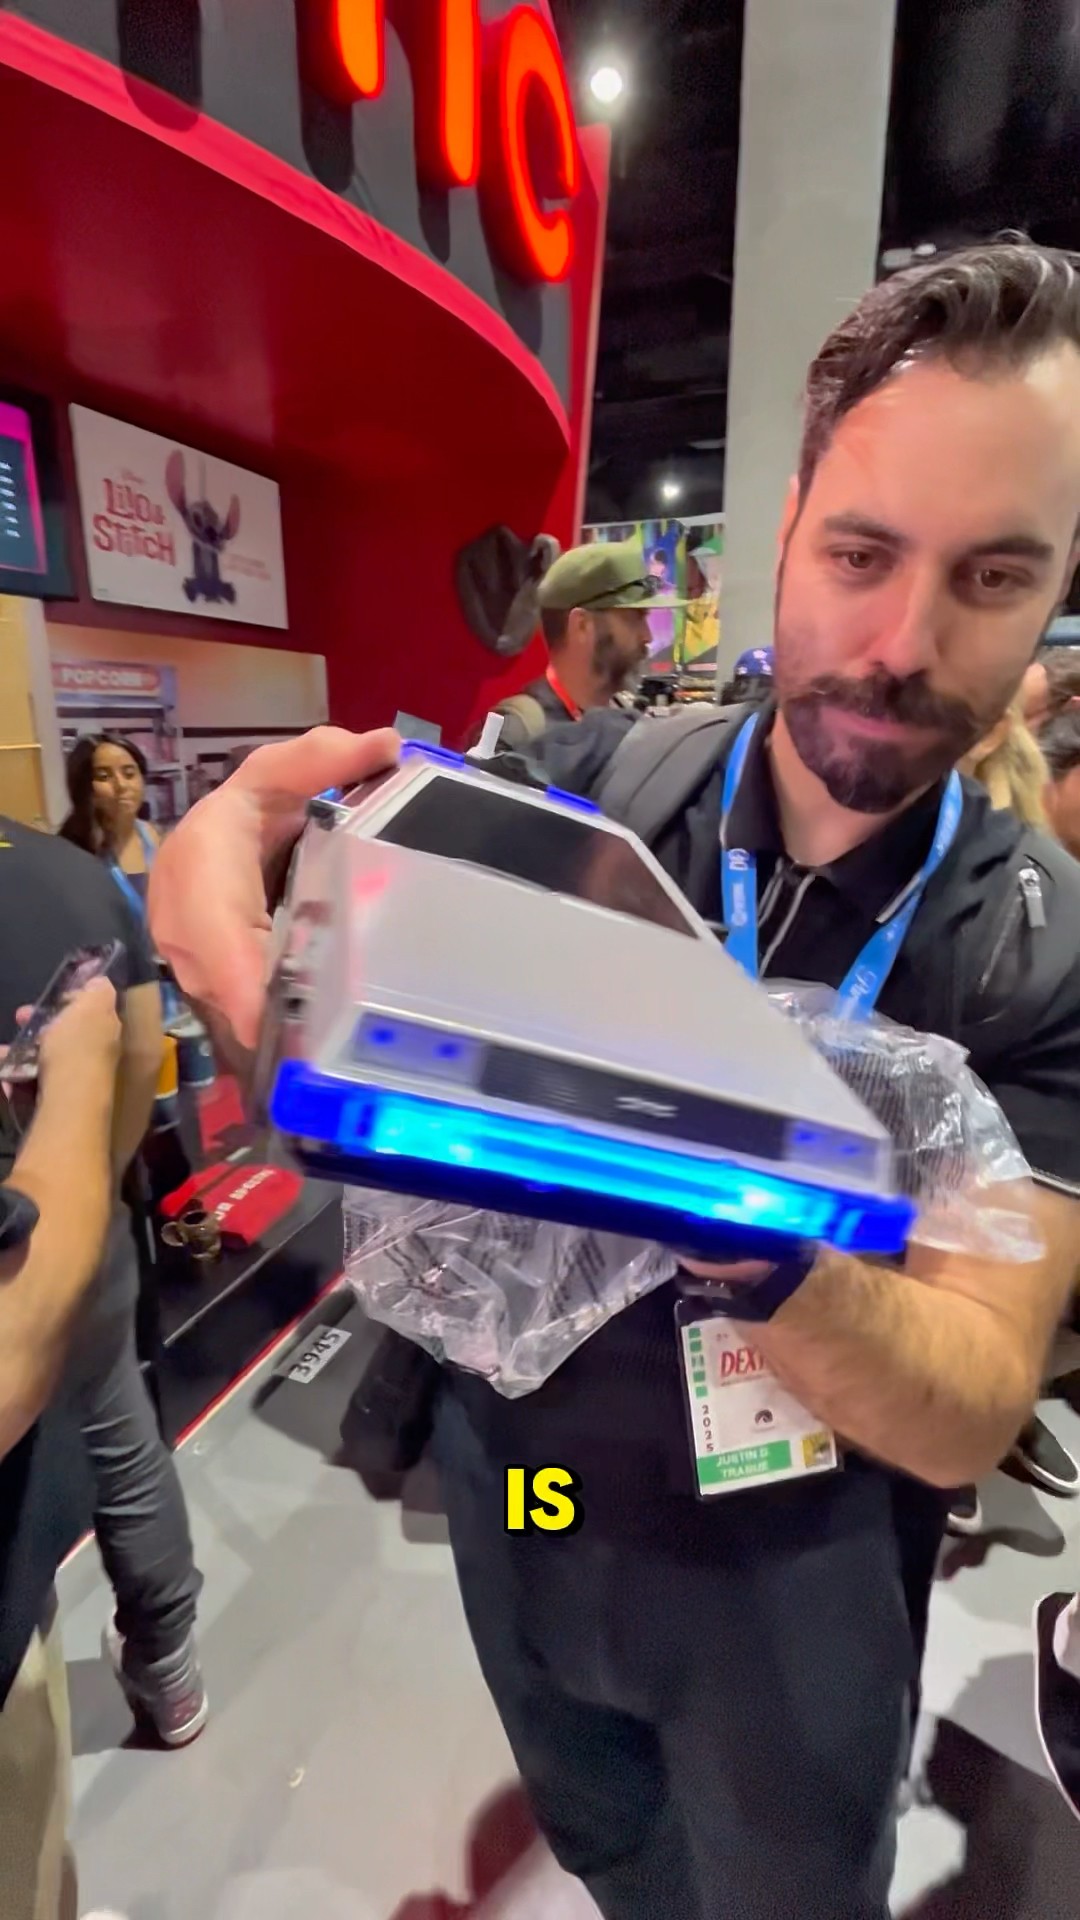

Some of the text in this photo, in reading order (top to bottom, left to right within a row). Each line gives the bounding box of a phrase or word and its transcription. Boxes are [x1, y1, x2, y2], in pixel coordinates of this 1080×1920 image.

[288, 1330, 341, 1378] 3945
[701, 1404, 715, 1453] 2025
[716, 1448, 758, 1468] JUSTIN
